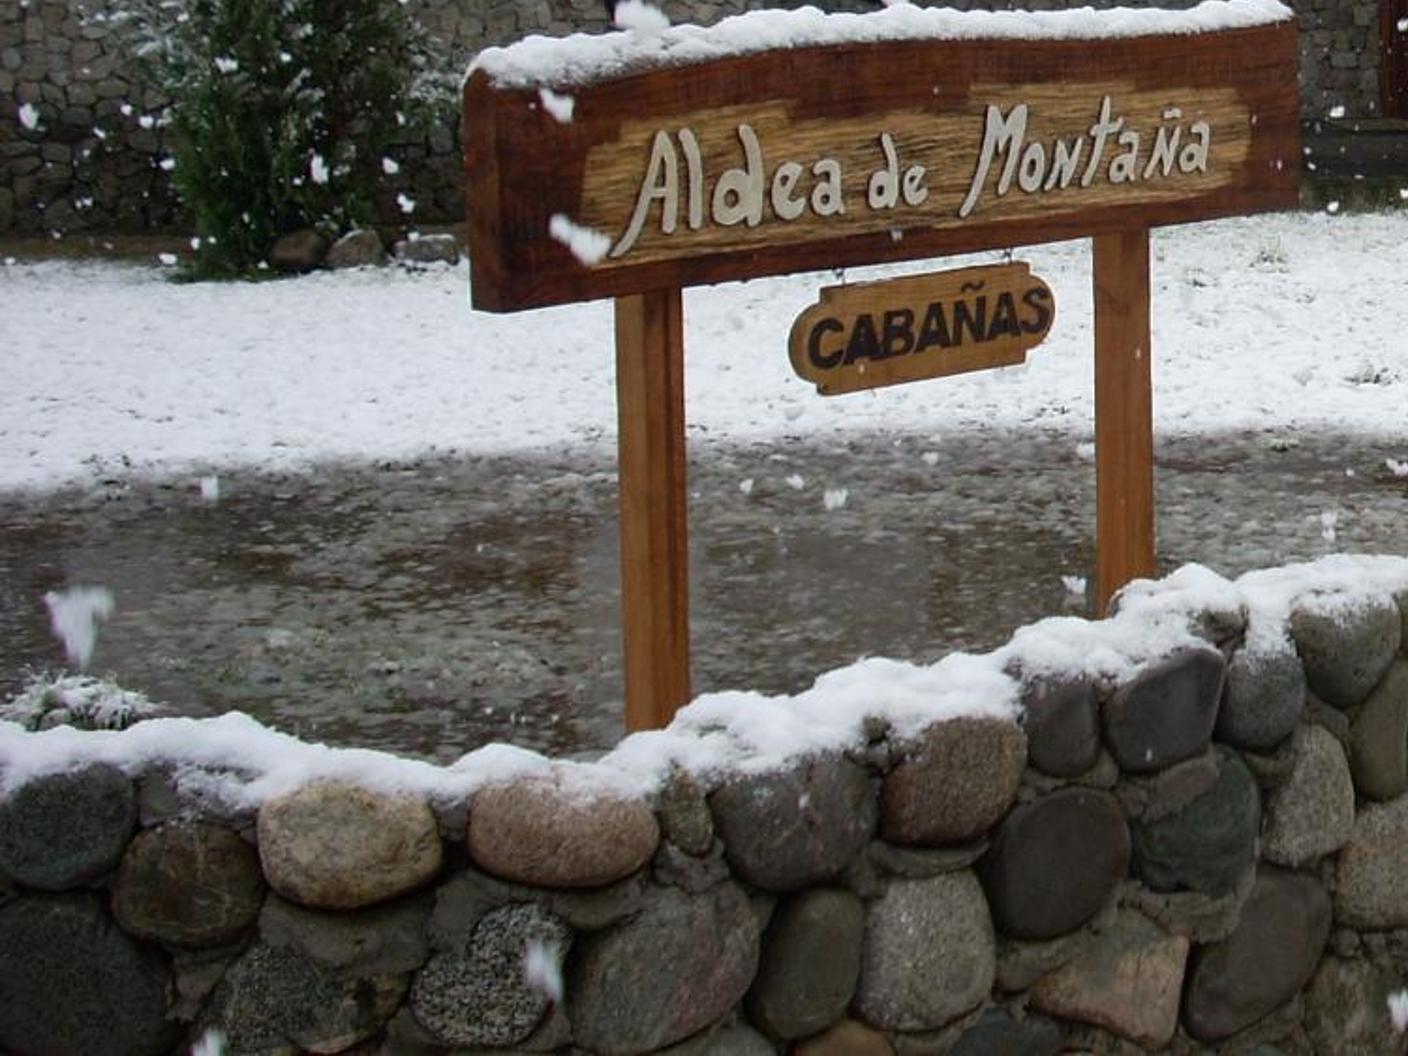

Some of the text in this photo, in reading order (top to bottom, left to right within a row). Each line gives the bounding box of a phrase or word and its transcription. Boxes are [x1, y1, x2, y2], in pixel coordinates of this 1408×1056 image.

[608, 124, 845, 258] Aldea
[868, 133, 928, 208] de
[807, 280, 1051, 371] CABAÑAS
